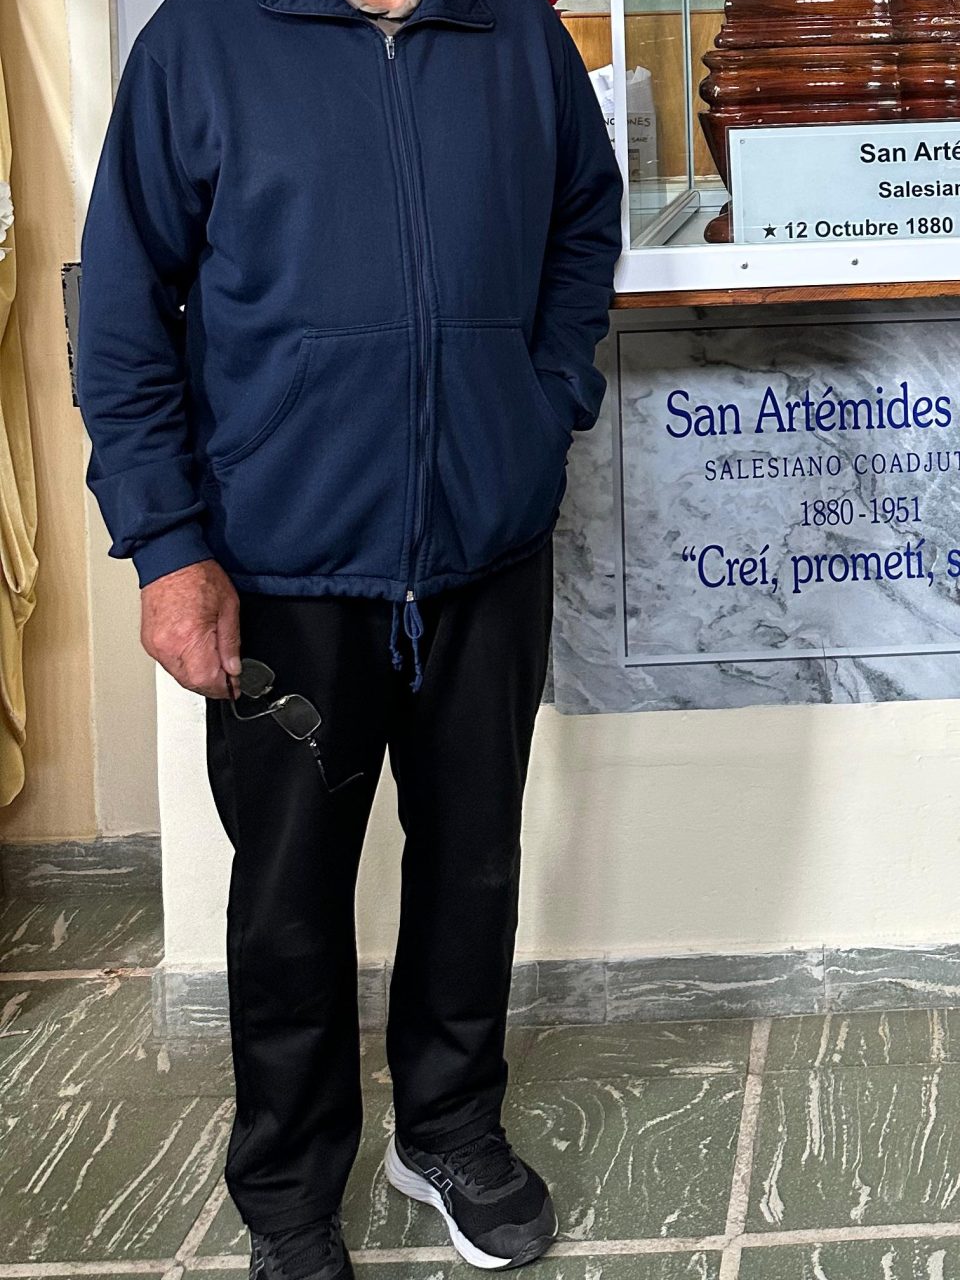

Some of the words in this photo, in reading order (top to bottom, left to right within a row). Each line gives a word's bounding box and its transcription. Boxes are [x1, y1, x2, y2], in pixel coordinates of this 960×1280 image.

[859, 143, 907, 164] San
[784, 222, 808, 239] 12
[814, 219, 899, 238] Octubre
[905, 216, 954, 235] 1880
[666, 389, 742, 438] San
[754, 381, 952, 434] Artémides
[705, 455, 841, 481] SALESIANO
[791, 538, 935, 594] prometí,
